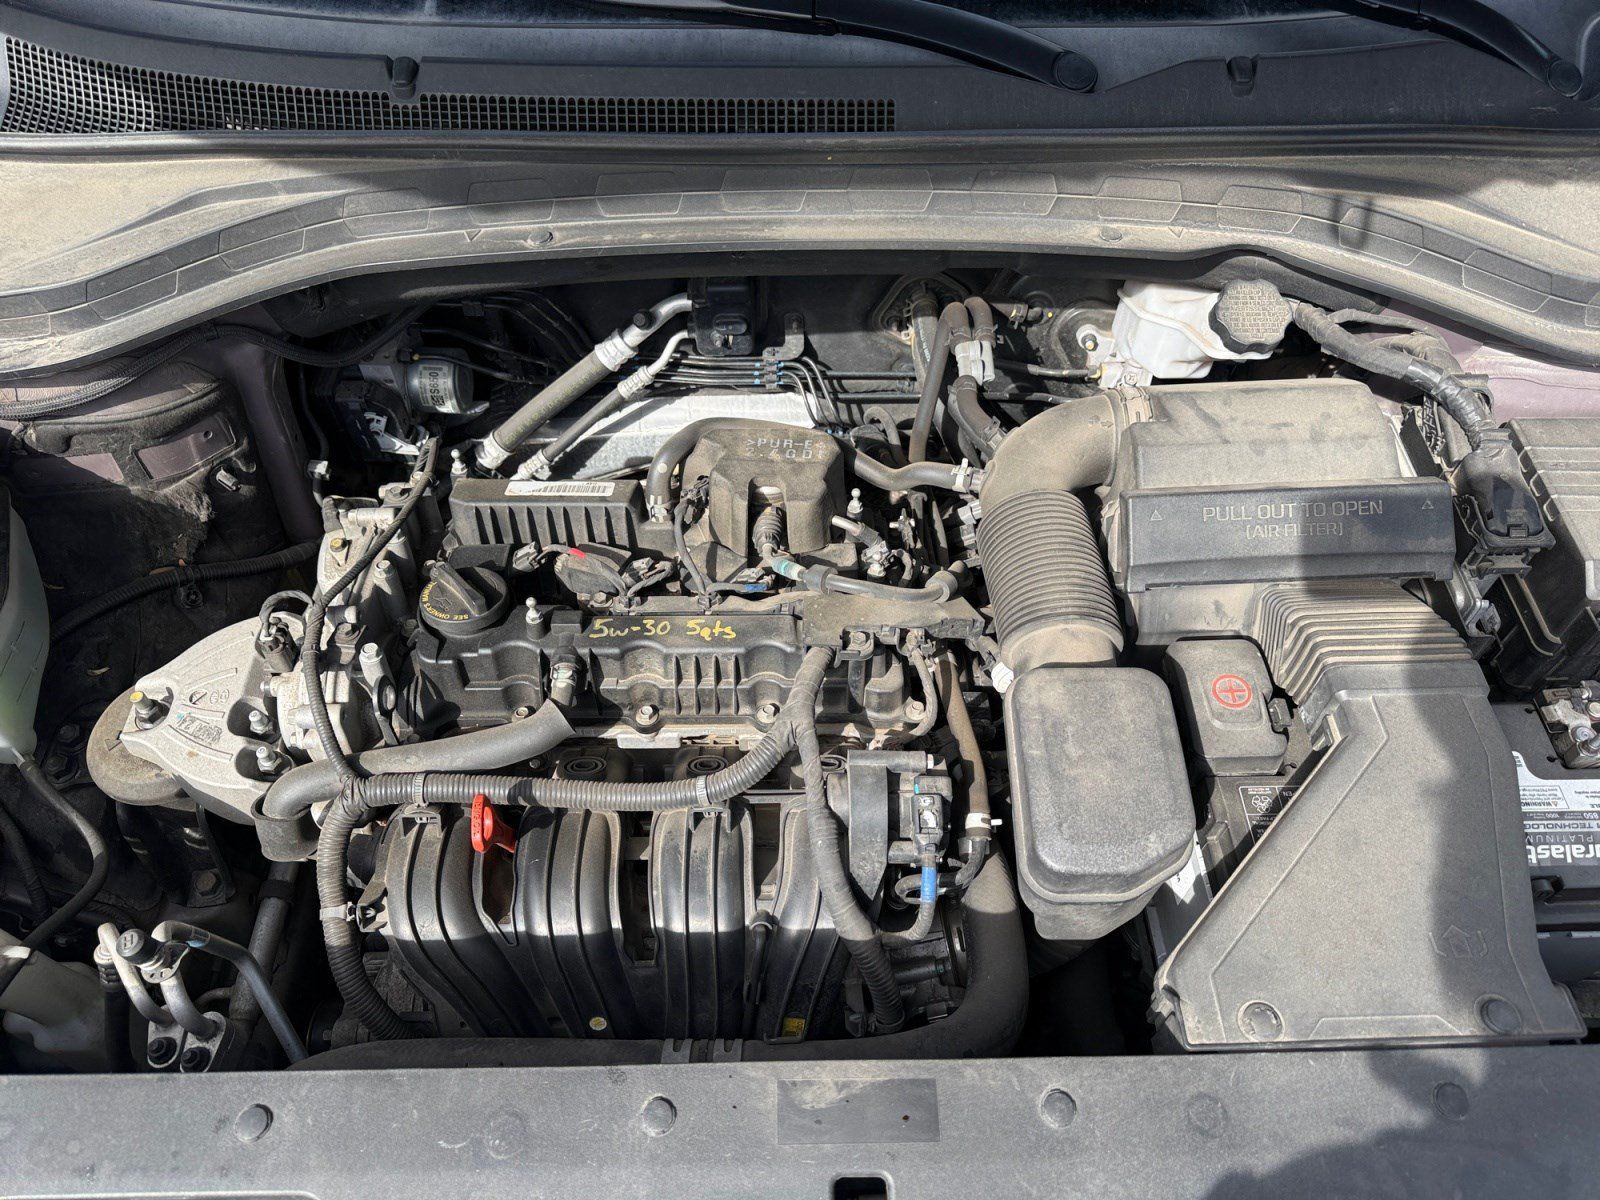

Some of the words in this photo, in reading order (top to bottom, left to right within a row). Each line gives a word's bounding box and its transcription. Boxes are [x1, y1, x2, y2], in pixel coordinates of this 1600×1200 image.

[1202, 506, 1253, 522] PULL
[1257, 503, 1298, 519] OUT
[1301, 502, 1327, 517] TO
[1331, 499, 1384, 516] OPEN
[1524, 822, 1594, 830] TECHNOLOG
